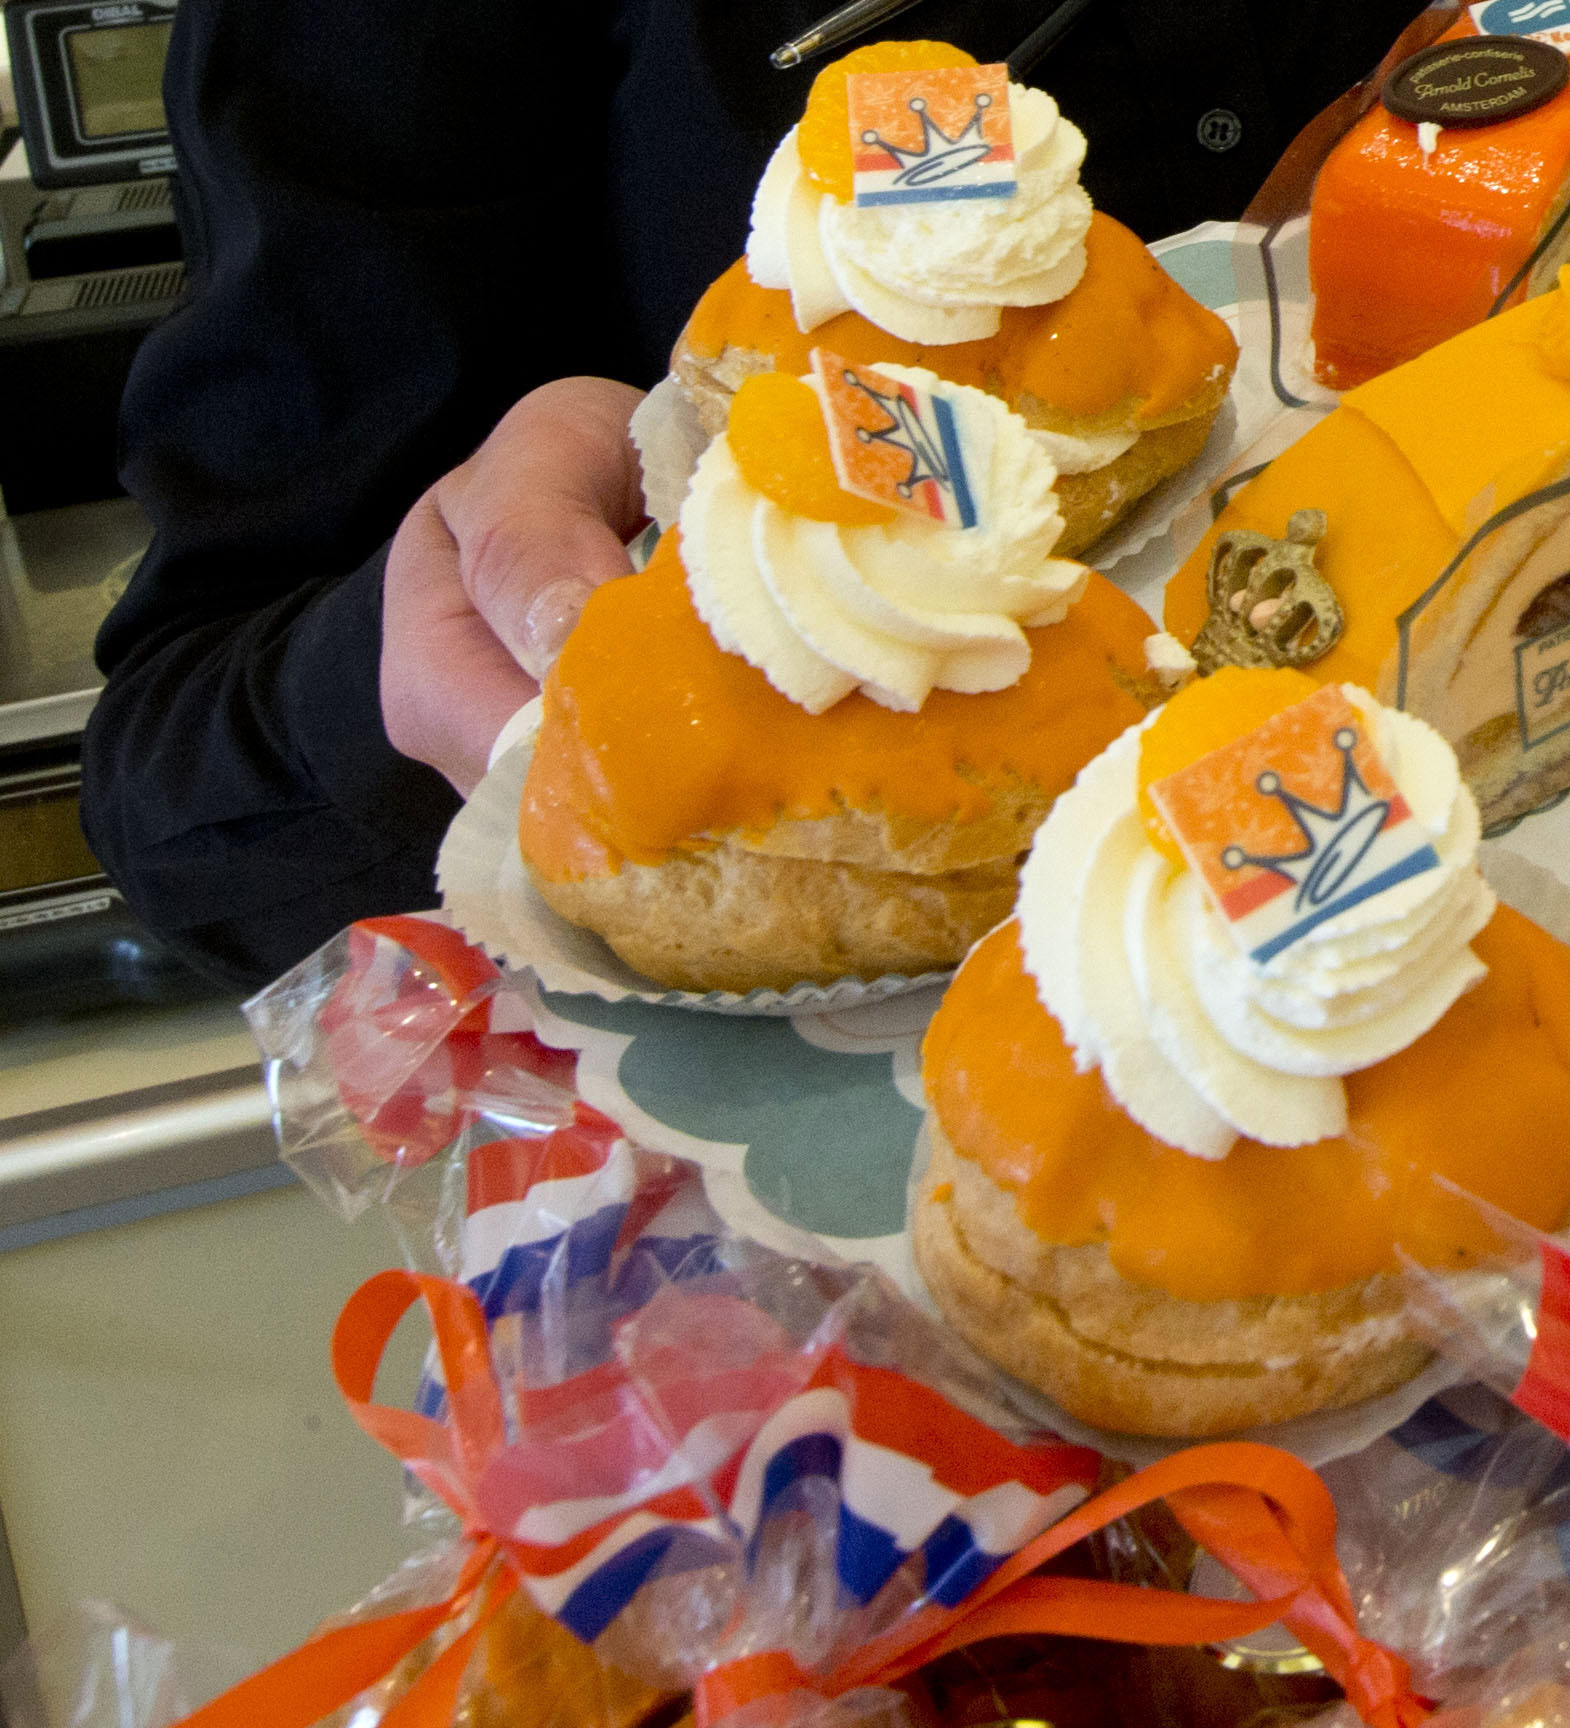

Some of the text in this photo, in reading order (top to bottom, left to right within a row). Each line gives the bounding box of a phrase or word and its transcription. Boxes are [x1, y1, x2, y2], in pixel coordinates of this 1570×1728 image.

[1414, 66, 1537, 101] Arnold Cornelis
[1439, 86, 1528, 113] AMSTERDAM
